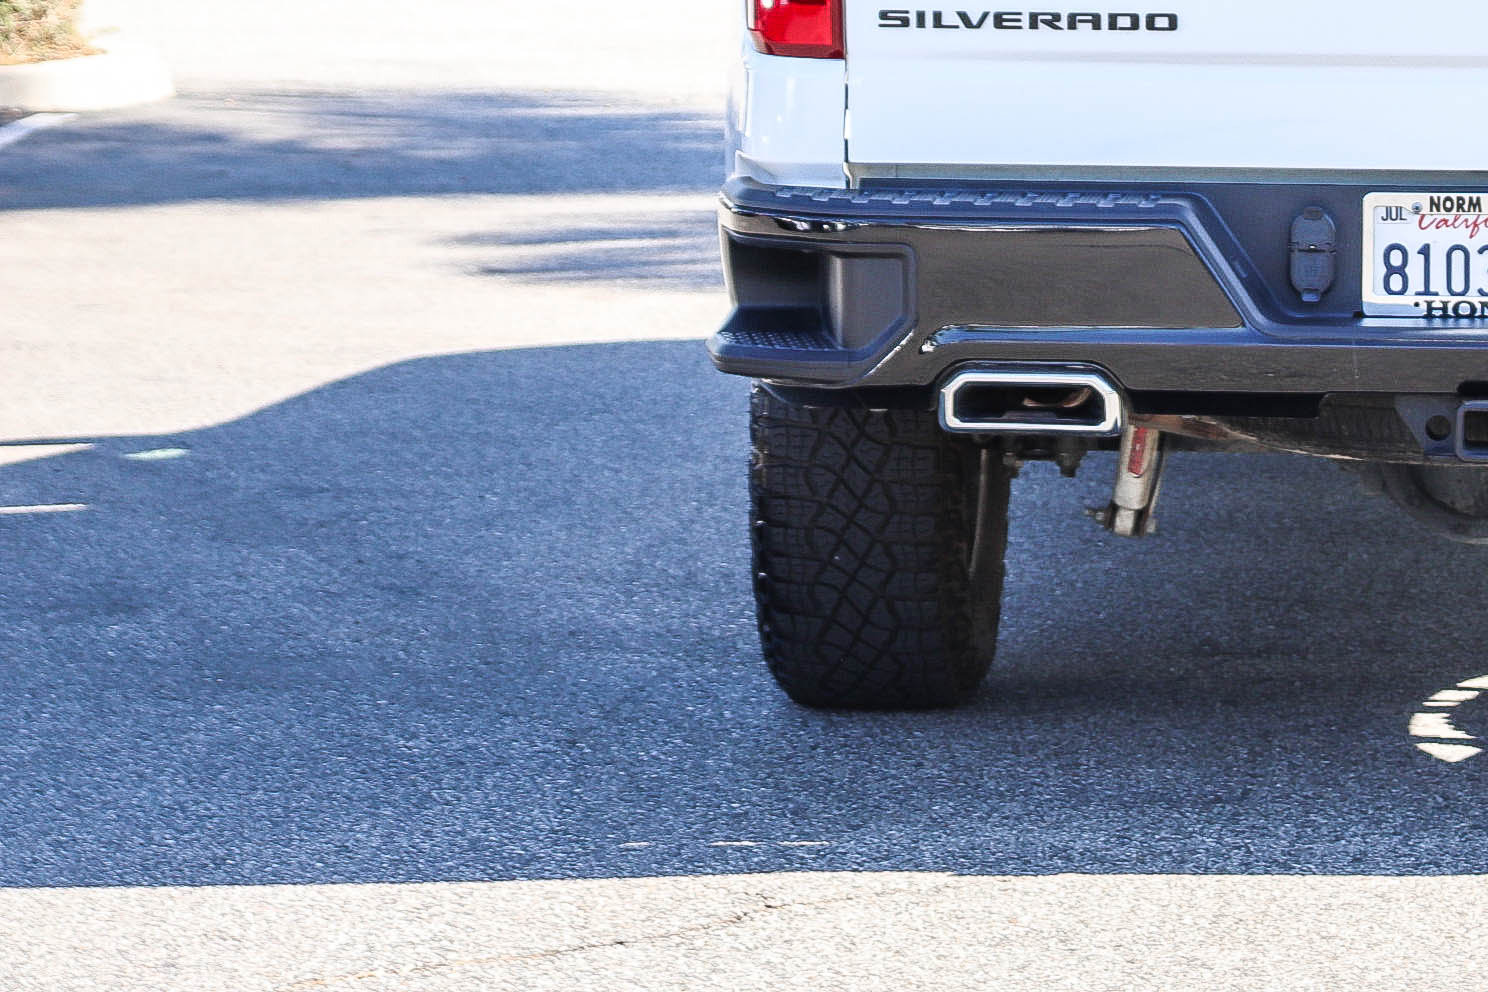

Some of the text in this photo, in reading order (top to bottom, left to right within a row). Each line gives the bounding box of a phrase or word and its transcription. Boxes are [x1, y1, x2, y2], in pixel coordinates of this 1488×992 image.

[878, 9, 1178, 32] SILVERADO
[1429, 195, 1482, 213] NORM
[1380, 205, 1408, 222] JUL
